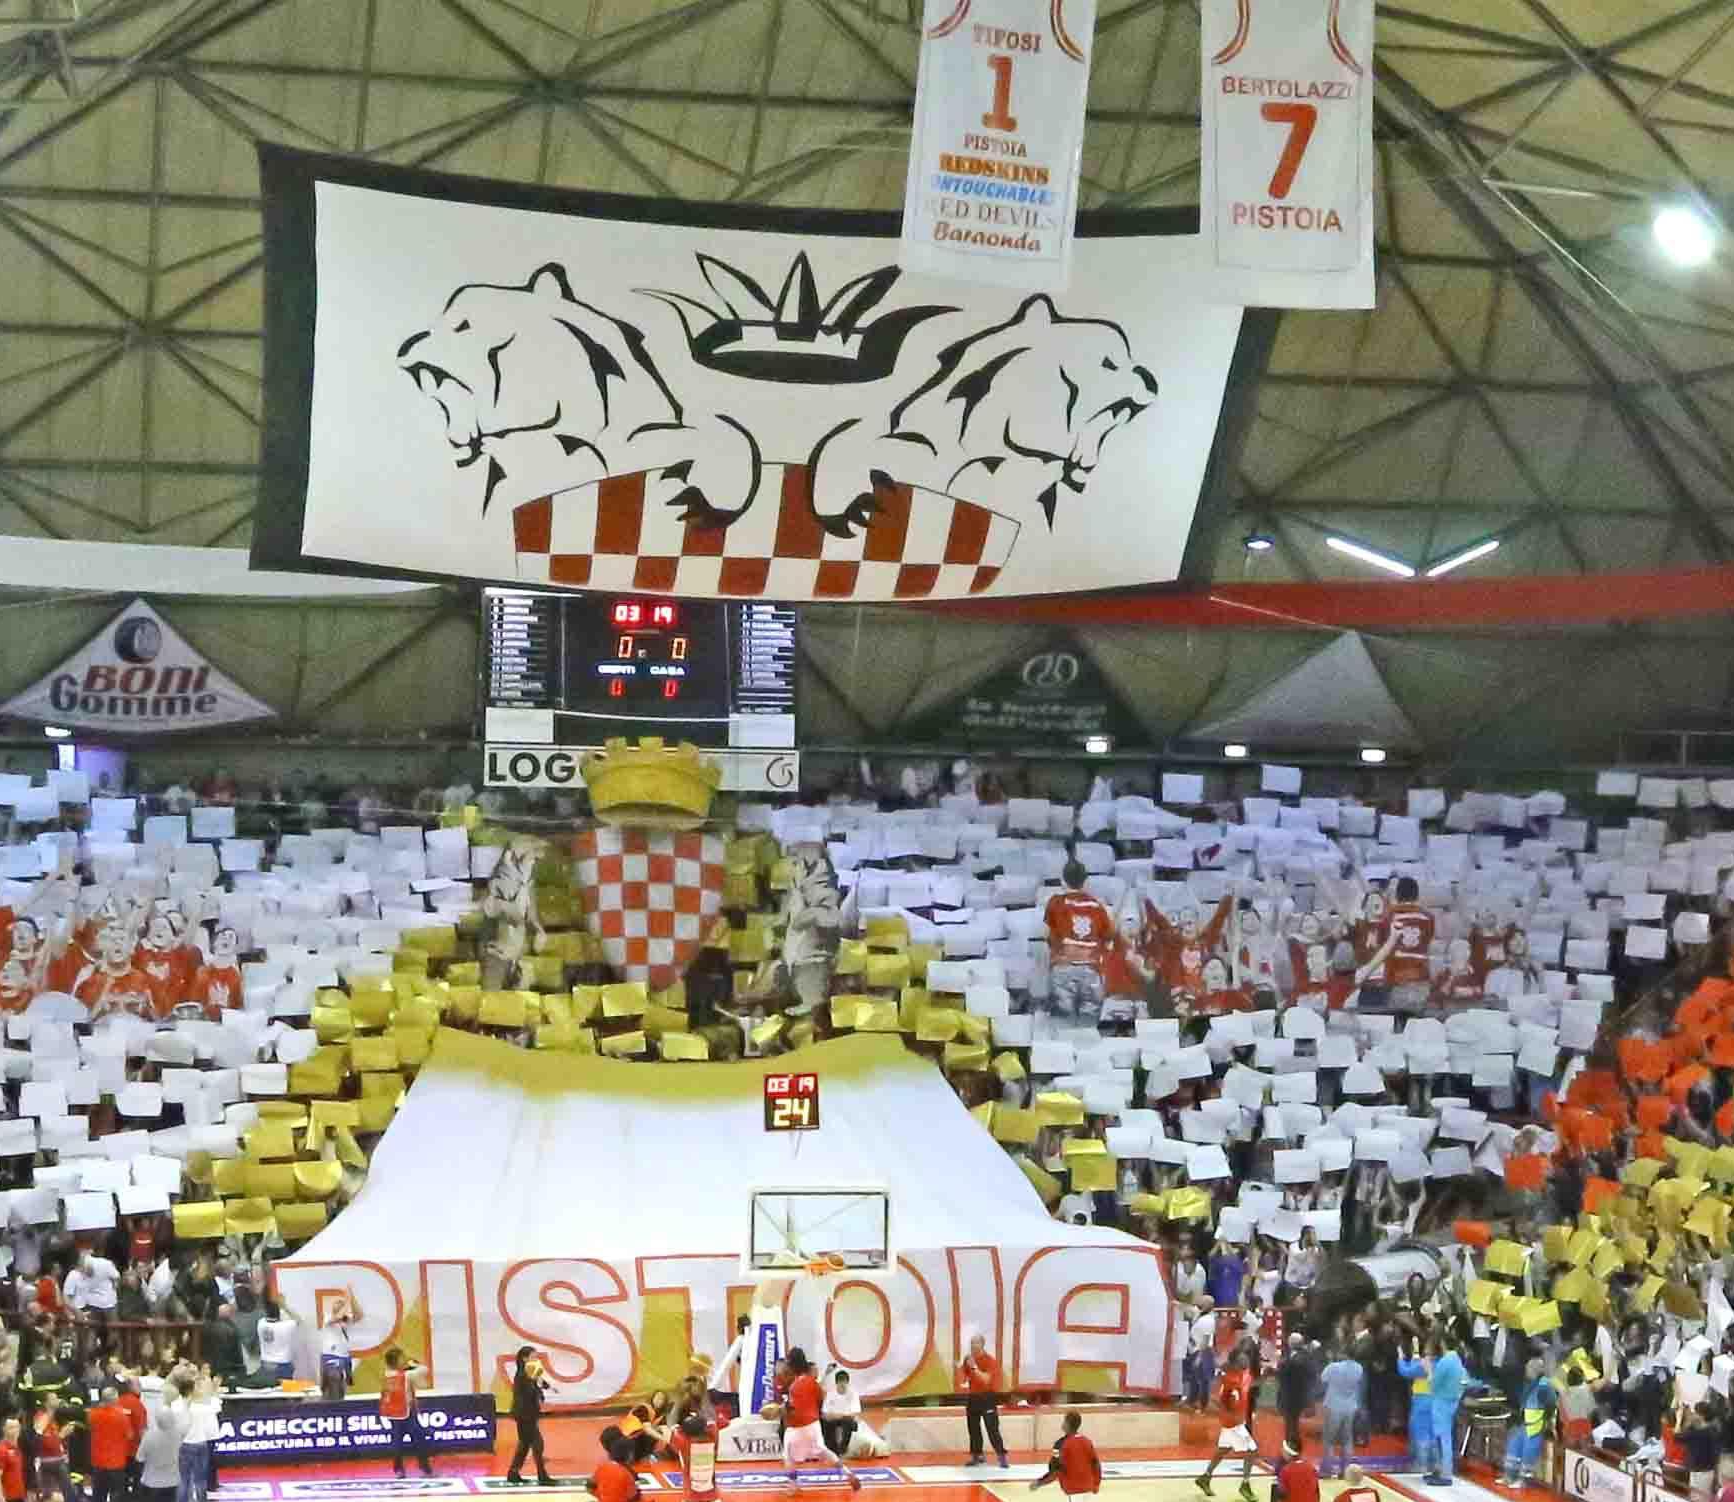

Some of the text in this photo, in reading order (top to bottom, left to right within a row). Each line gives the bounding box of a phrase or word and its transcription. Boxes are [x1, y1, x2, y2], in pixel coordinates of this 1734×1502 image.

[973, 25, 1042, 52] TIFOSI
[982, 56, 1017, 131] 1
[1222, 76, 1353, 100] BERTOLAZZI
[964, 133, 1027, 157] PISTOIA
[1261, 103, 1317, 199] 7
[1232, 202, 1343, 233] PISTOIA
[619, 636, 686, 660] 0 0
[488, 752, 584, 784] LOG
[768, 1077, 789, 1093] 03
[774, 1098, 810, 1127] 24
[272, 1244, 1180, 1412] PISTOIA
[241, 1416, 343, 1437] CHECCHI
[434, 1429, 487, 1442] PISTOIA
